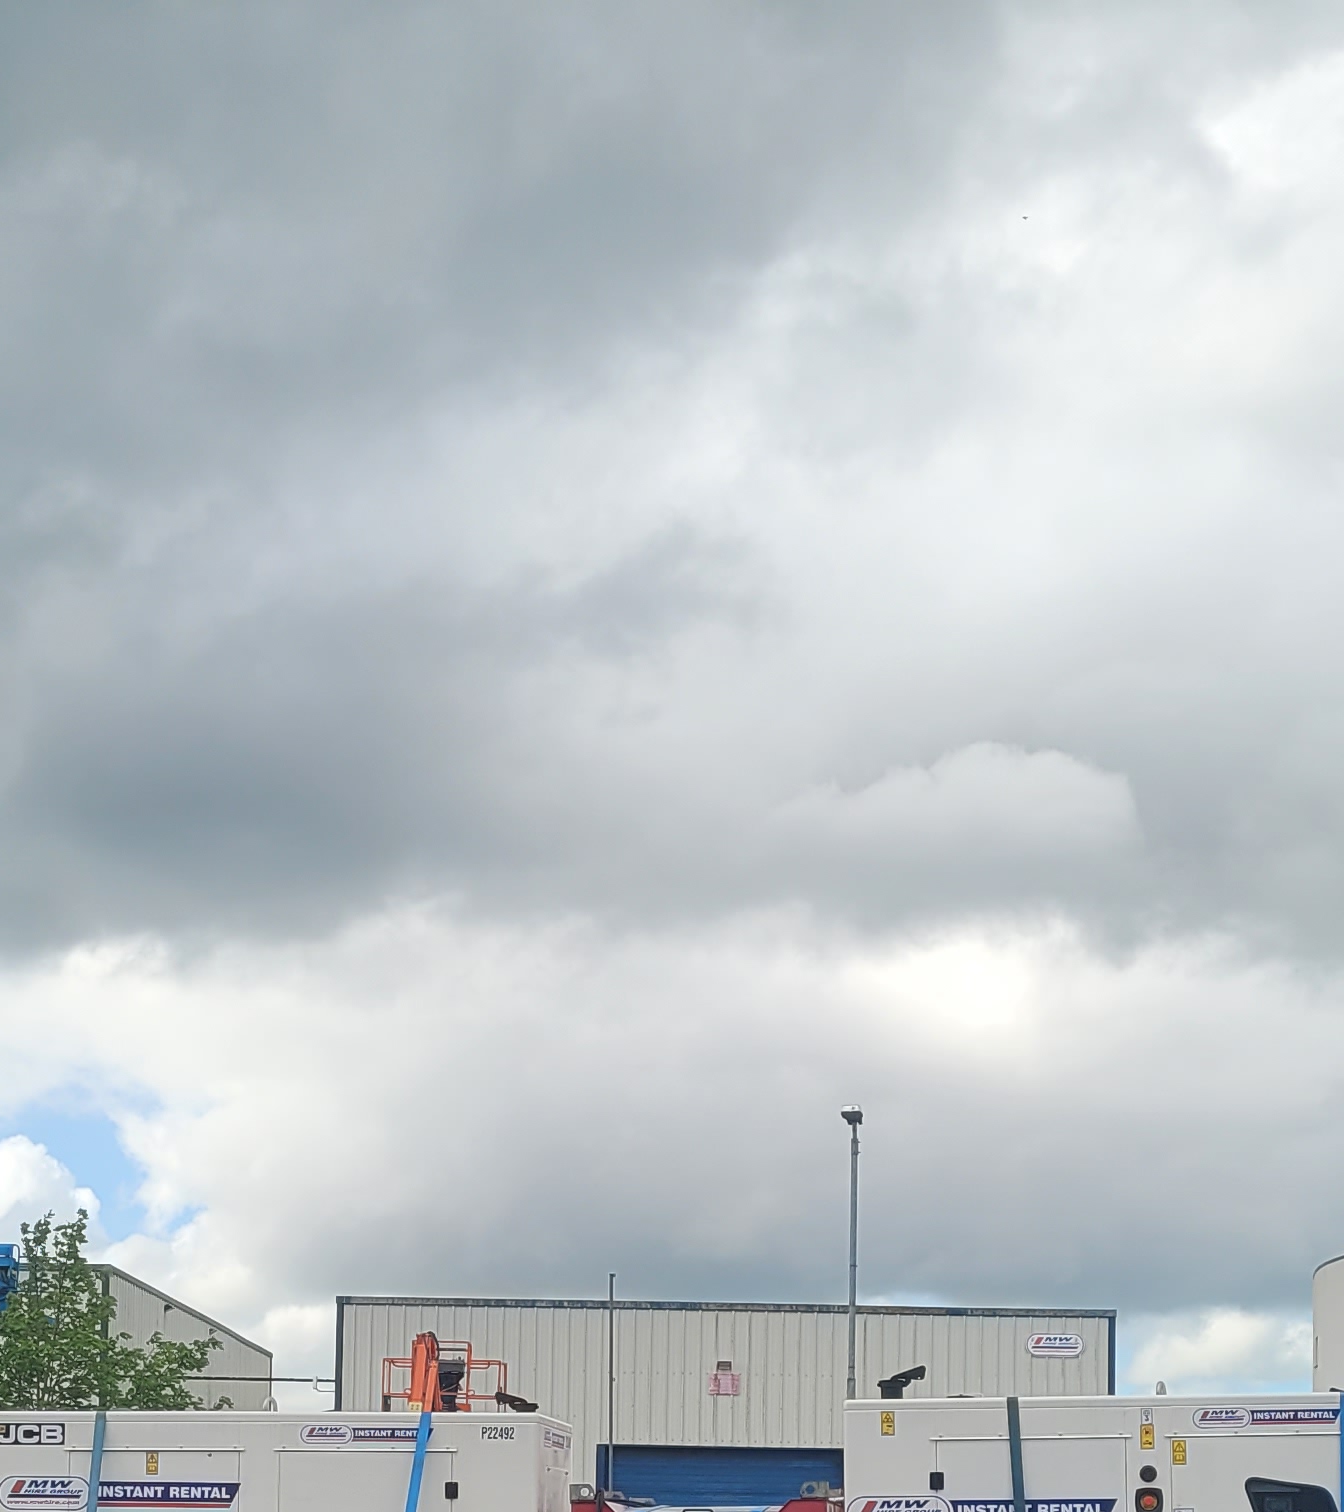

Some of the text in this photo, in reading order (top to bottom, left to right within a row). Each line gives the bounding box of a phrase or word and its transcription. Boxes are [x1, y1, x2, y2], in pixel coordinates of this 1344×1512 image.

[1254, 1411, 1336, 1420] INSTANT RENTAL
[481, 1427, 515, 1440] P22492
[27, 1480, 74, 1488] MW
[99, 1486, 231, 1499] INSTANT RENTAL
[879, 1500, 930, 1509] MW
